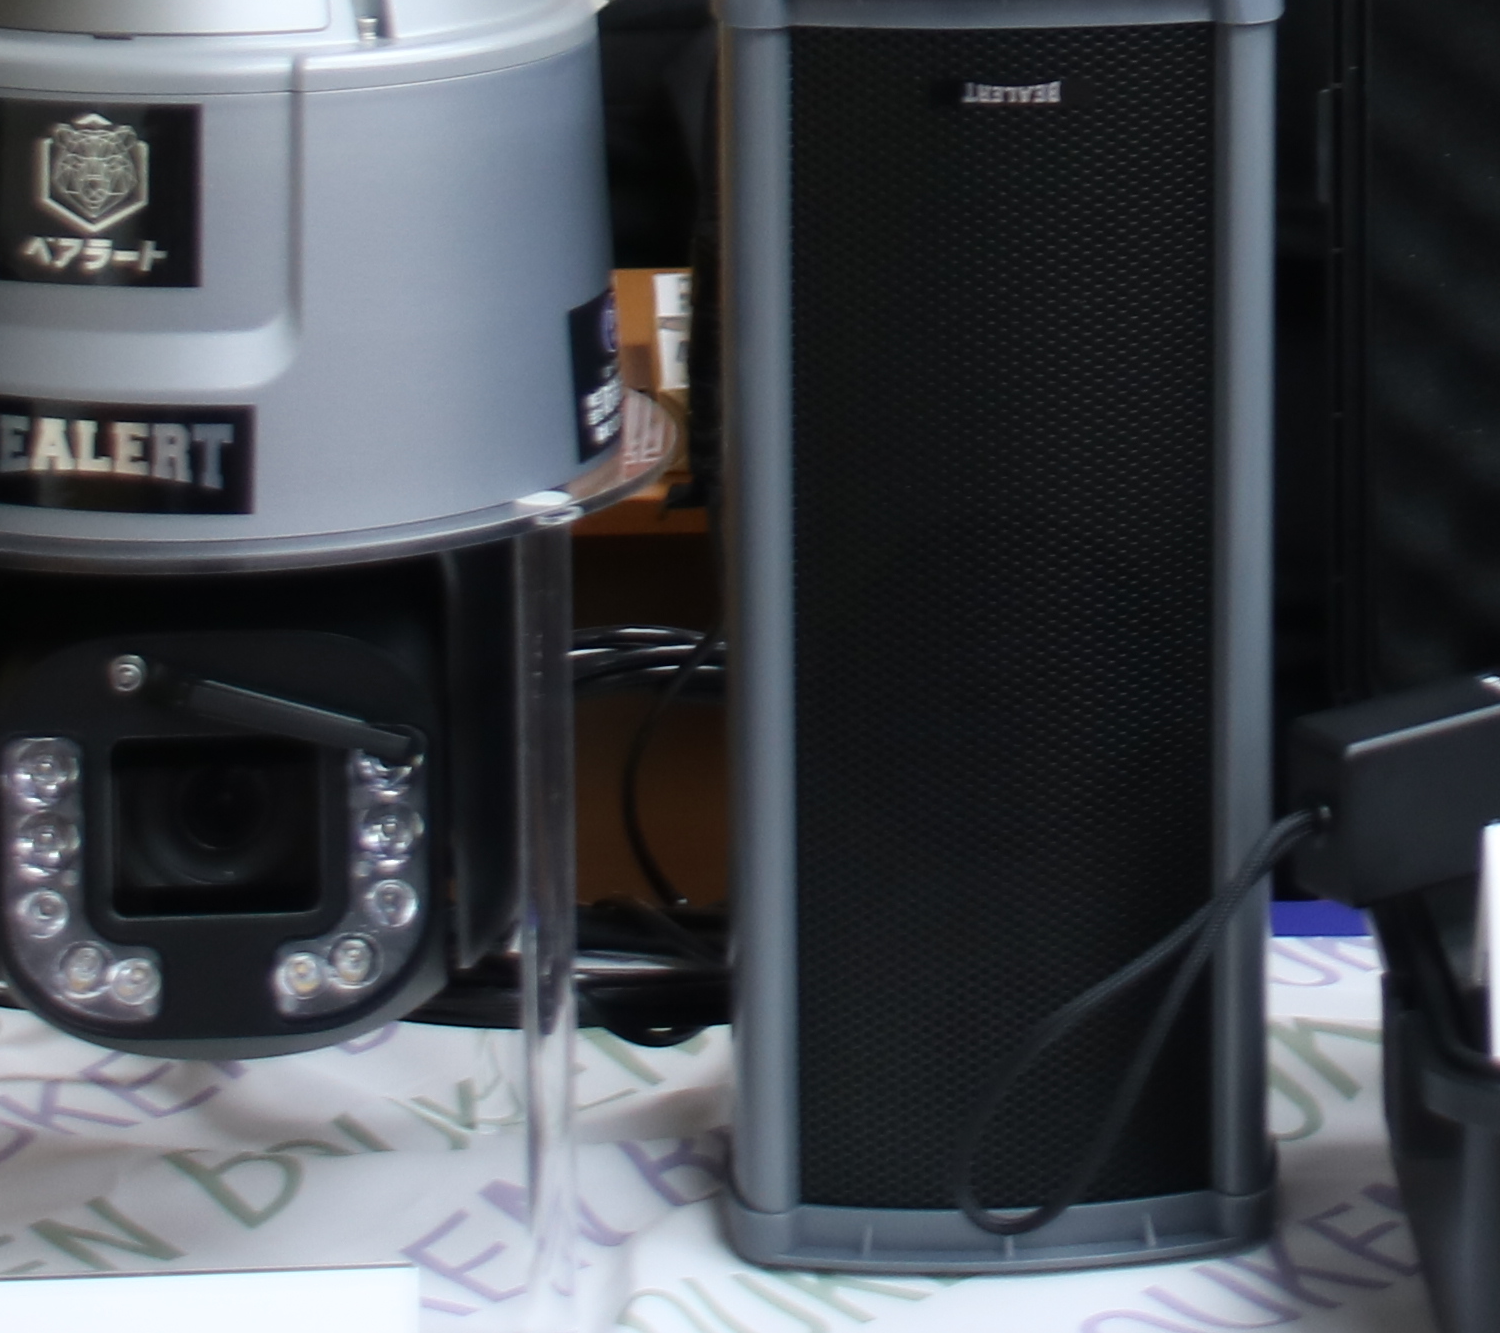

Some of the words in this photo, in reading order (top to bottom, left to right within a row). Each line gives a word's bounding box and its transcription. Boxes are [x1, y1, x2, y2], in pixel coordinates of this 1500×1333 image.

[23, 235, 169, 273] ベアラート
